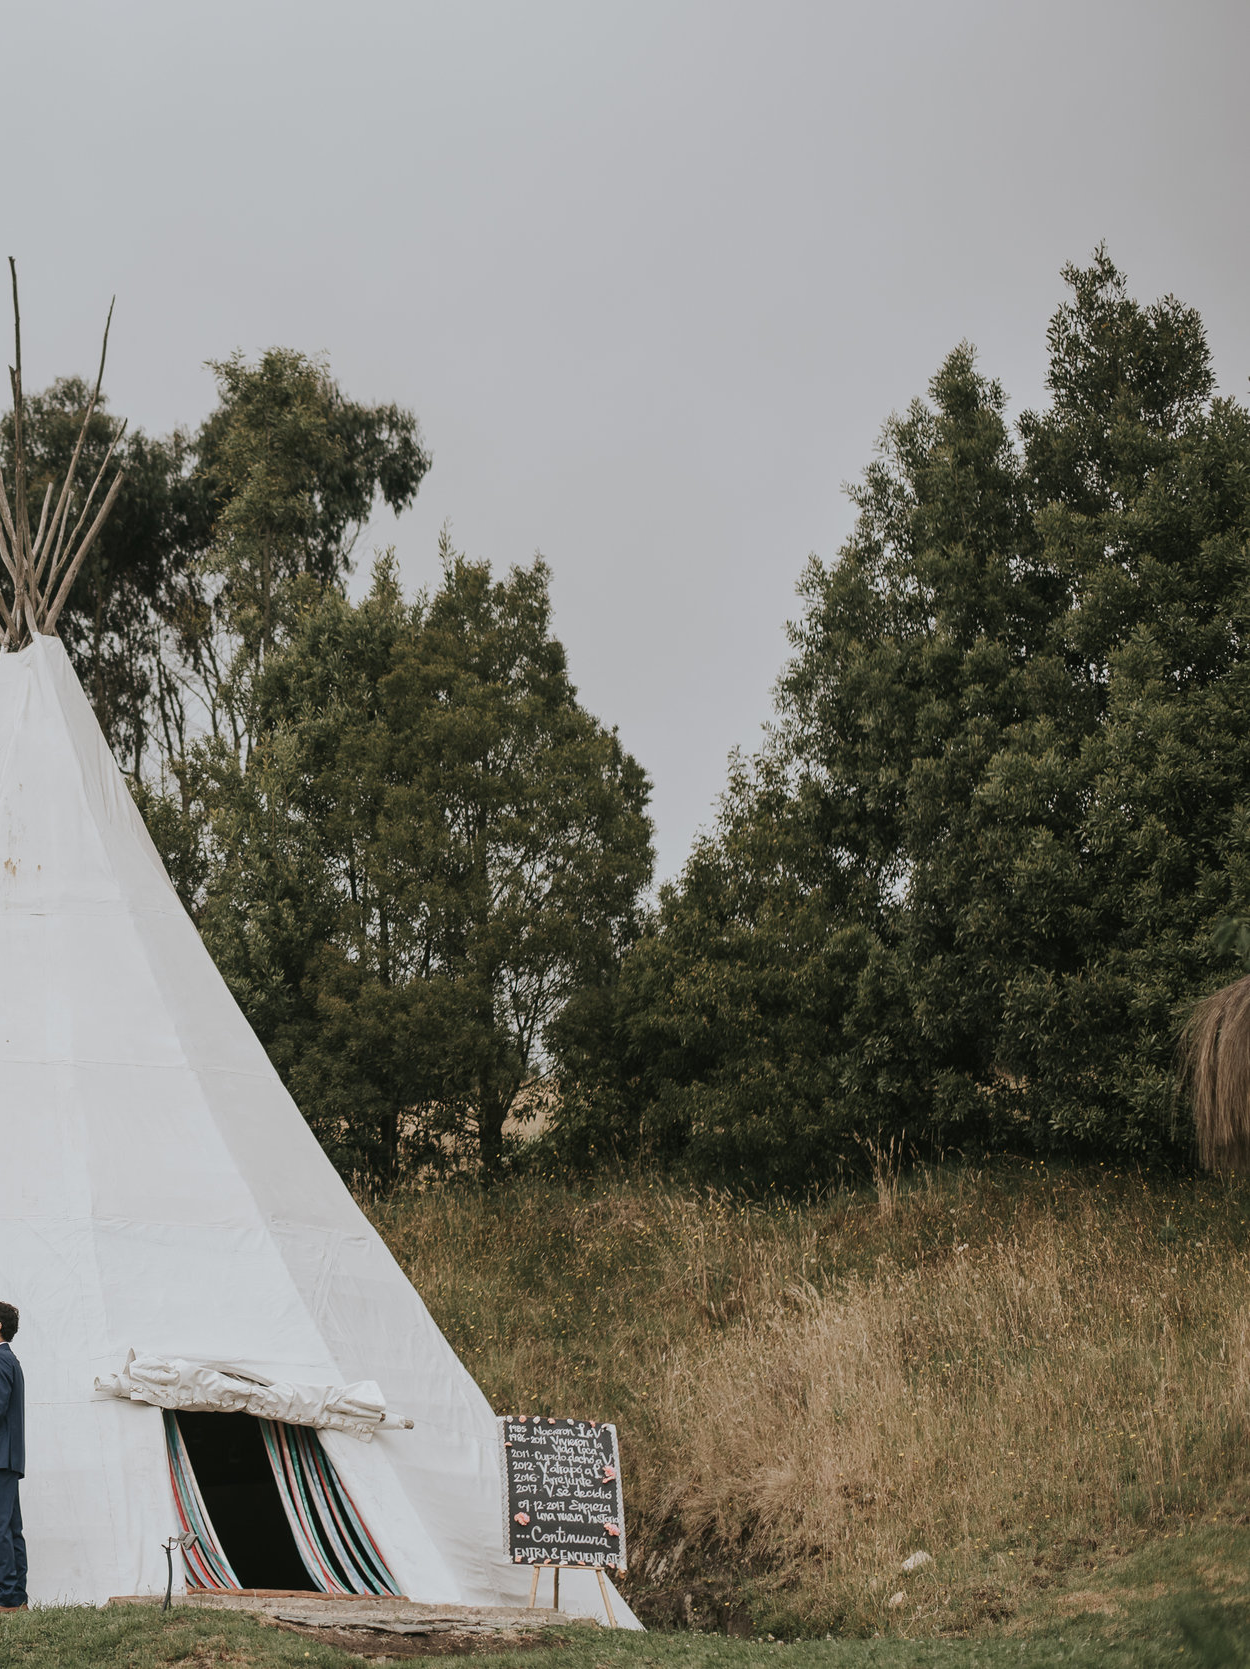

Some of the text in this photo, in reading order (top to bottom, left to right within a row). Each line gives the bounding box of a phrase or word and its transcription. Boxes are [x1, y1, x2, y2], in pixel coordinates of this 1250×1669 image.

[509, 1424, 527, 1434] 1985
[594, 1439, 603, 1449] la
[574, 1485, 612, 1499] decidió
[515, 1547, 550, 1560] ENTRA
[551, 1547, 560, 1560] &
